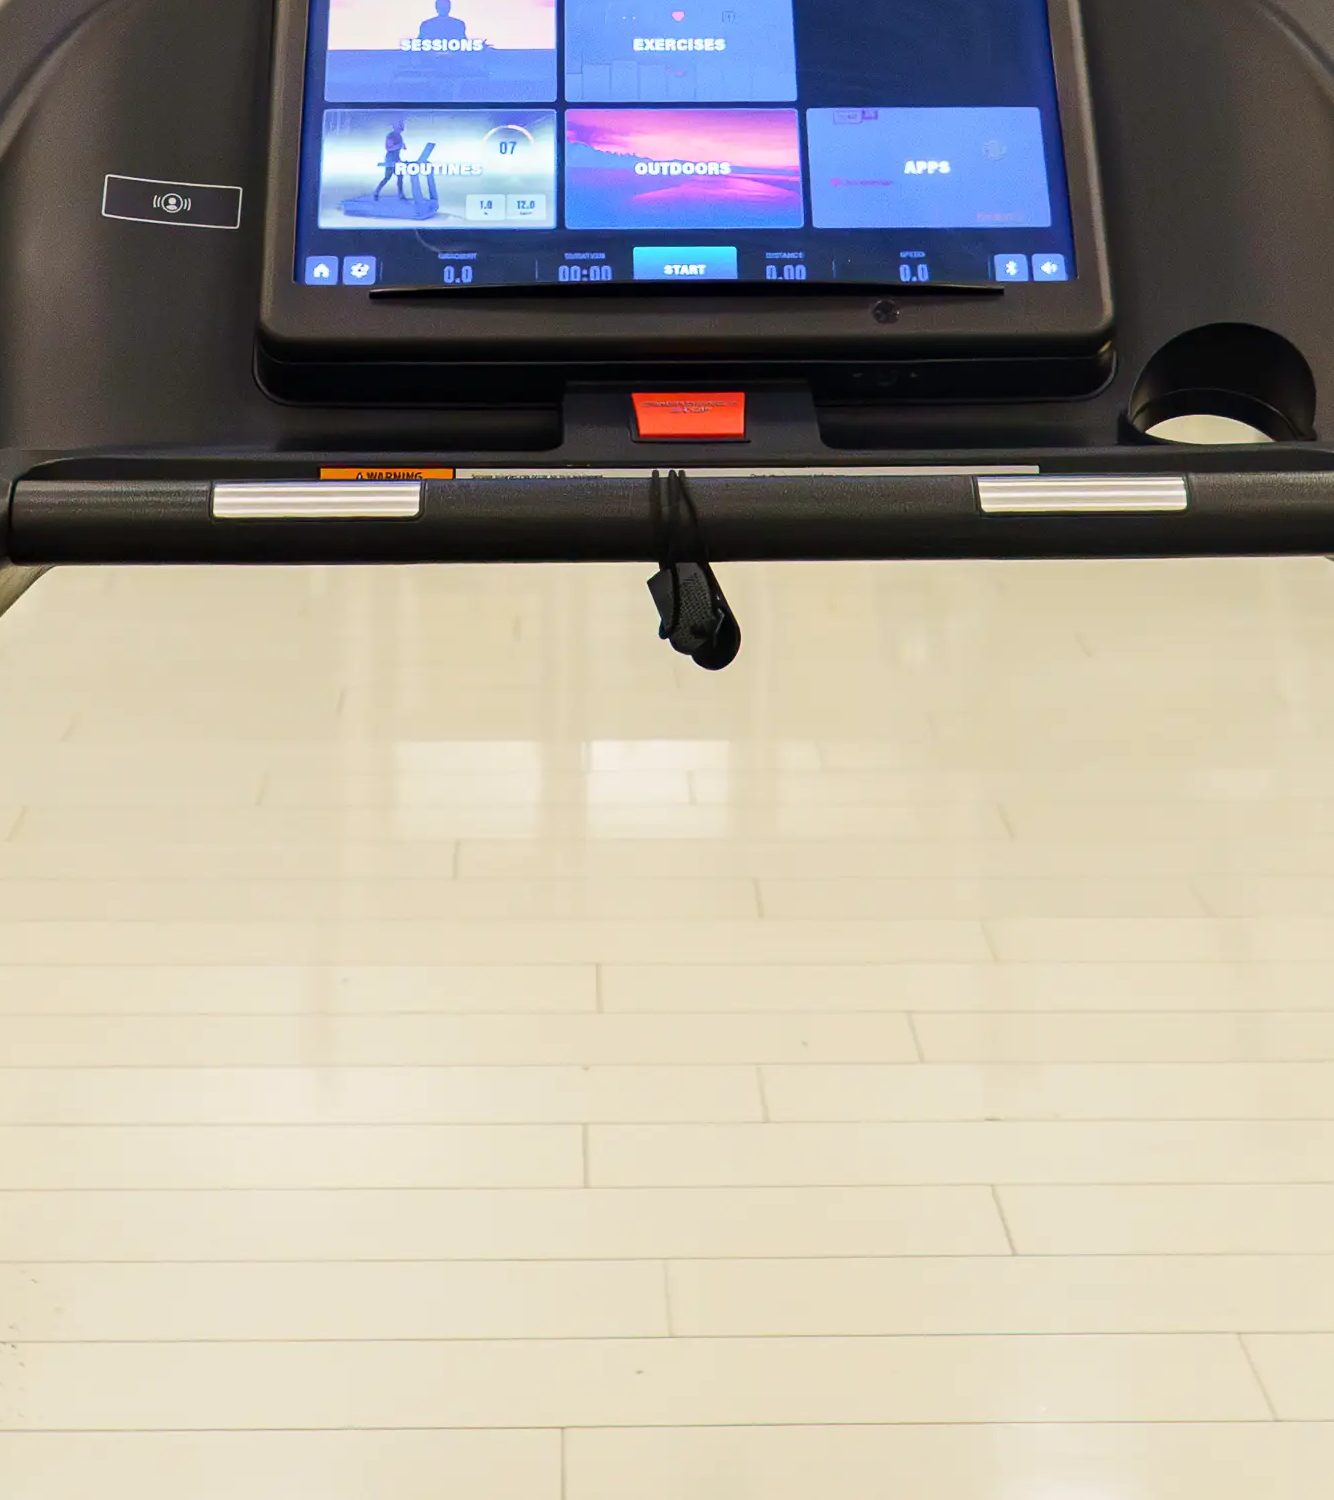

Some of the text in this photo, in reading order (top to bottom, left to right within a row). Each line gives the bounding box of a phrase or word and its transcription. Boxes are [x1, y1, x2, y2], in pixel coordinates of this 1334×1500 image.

[399, 38, 484, 52] SESSIONS
[632, 37, 727, 51] EXERCISES
[499, 141, 517, 155] 07
[394, 162, 483, 176] ROUTINES
[634, 161, 732, 175] OUTDOORS
[903, 160, 951, 175] APPS
[443, 265, 473, 283] 0.0
[558, 265, 613, 282] 00:00
[663, 264, 707, 275] START
[765, 264, 807, 280] 0.00
[899, 264, 929, 282] 0.0
[367, 471, 423, 480] WARNING
